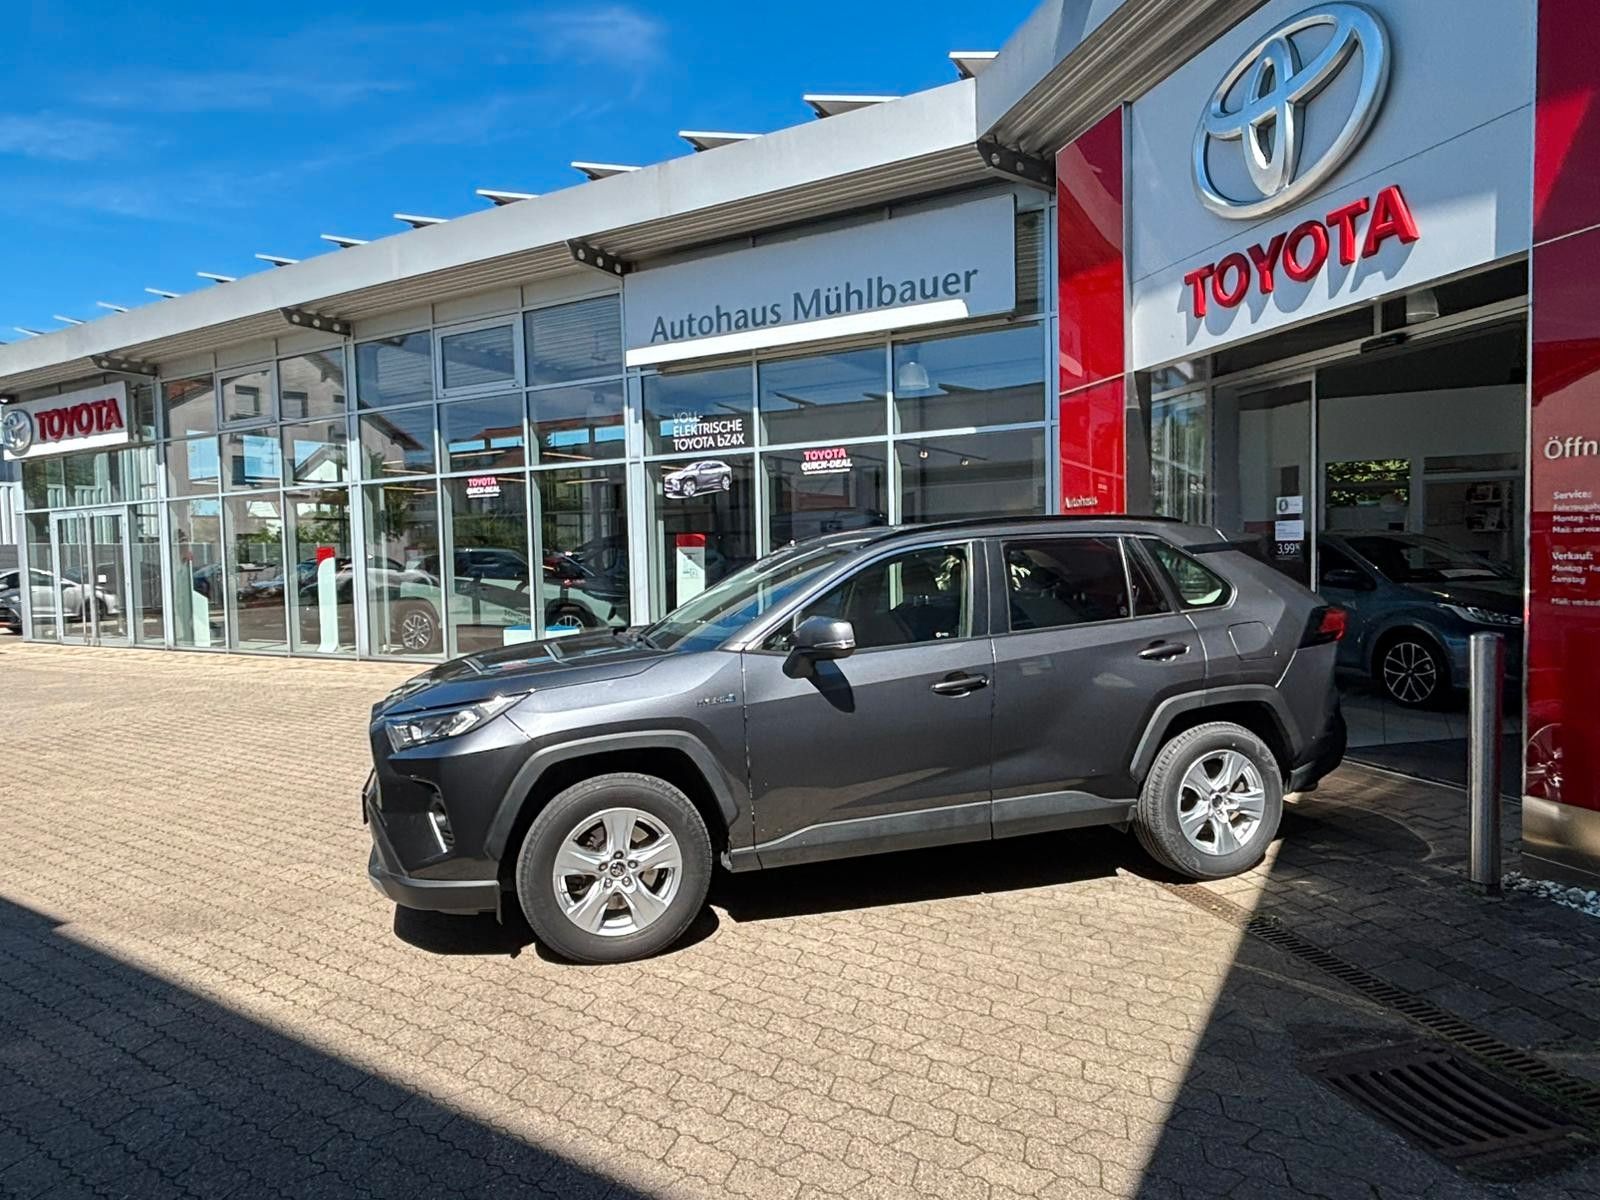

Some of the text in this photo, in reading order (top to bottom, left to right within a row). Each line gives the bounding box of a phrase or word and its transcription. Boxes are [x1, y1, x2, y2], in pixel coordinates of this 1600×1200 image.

[1184, 184, 1421, 319] TOYOTA
[650, 268, 979, 343] Autohaus Mühlbauer
[34, 398, 124, 442] TOYOTA
[673, 419, 743, 437] ELEKTRISCHE
[673, 433, 744, 451] TOYOTA bZ4X
[803, 448, 847, 461] TOYOTA
[801, 458, 853, 471] QUICK-DEAL
[468, 477, 497, 487] TOYOTA
